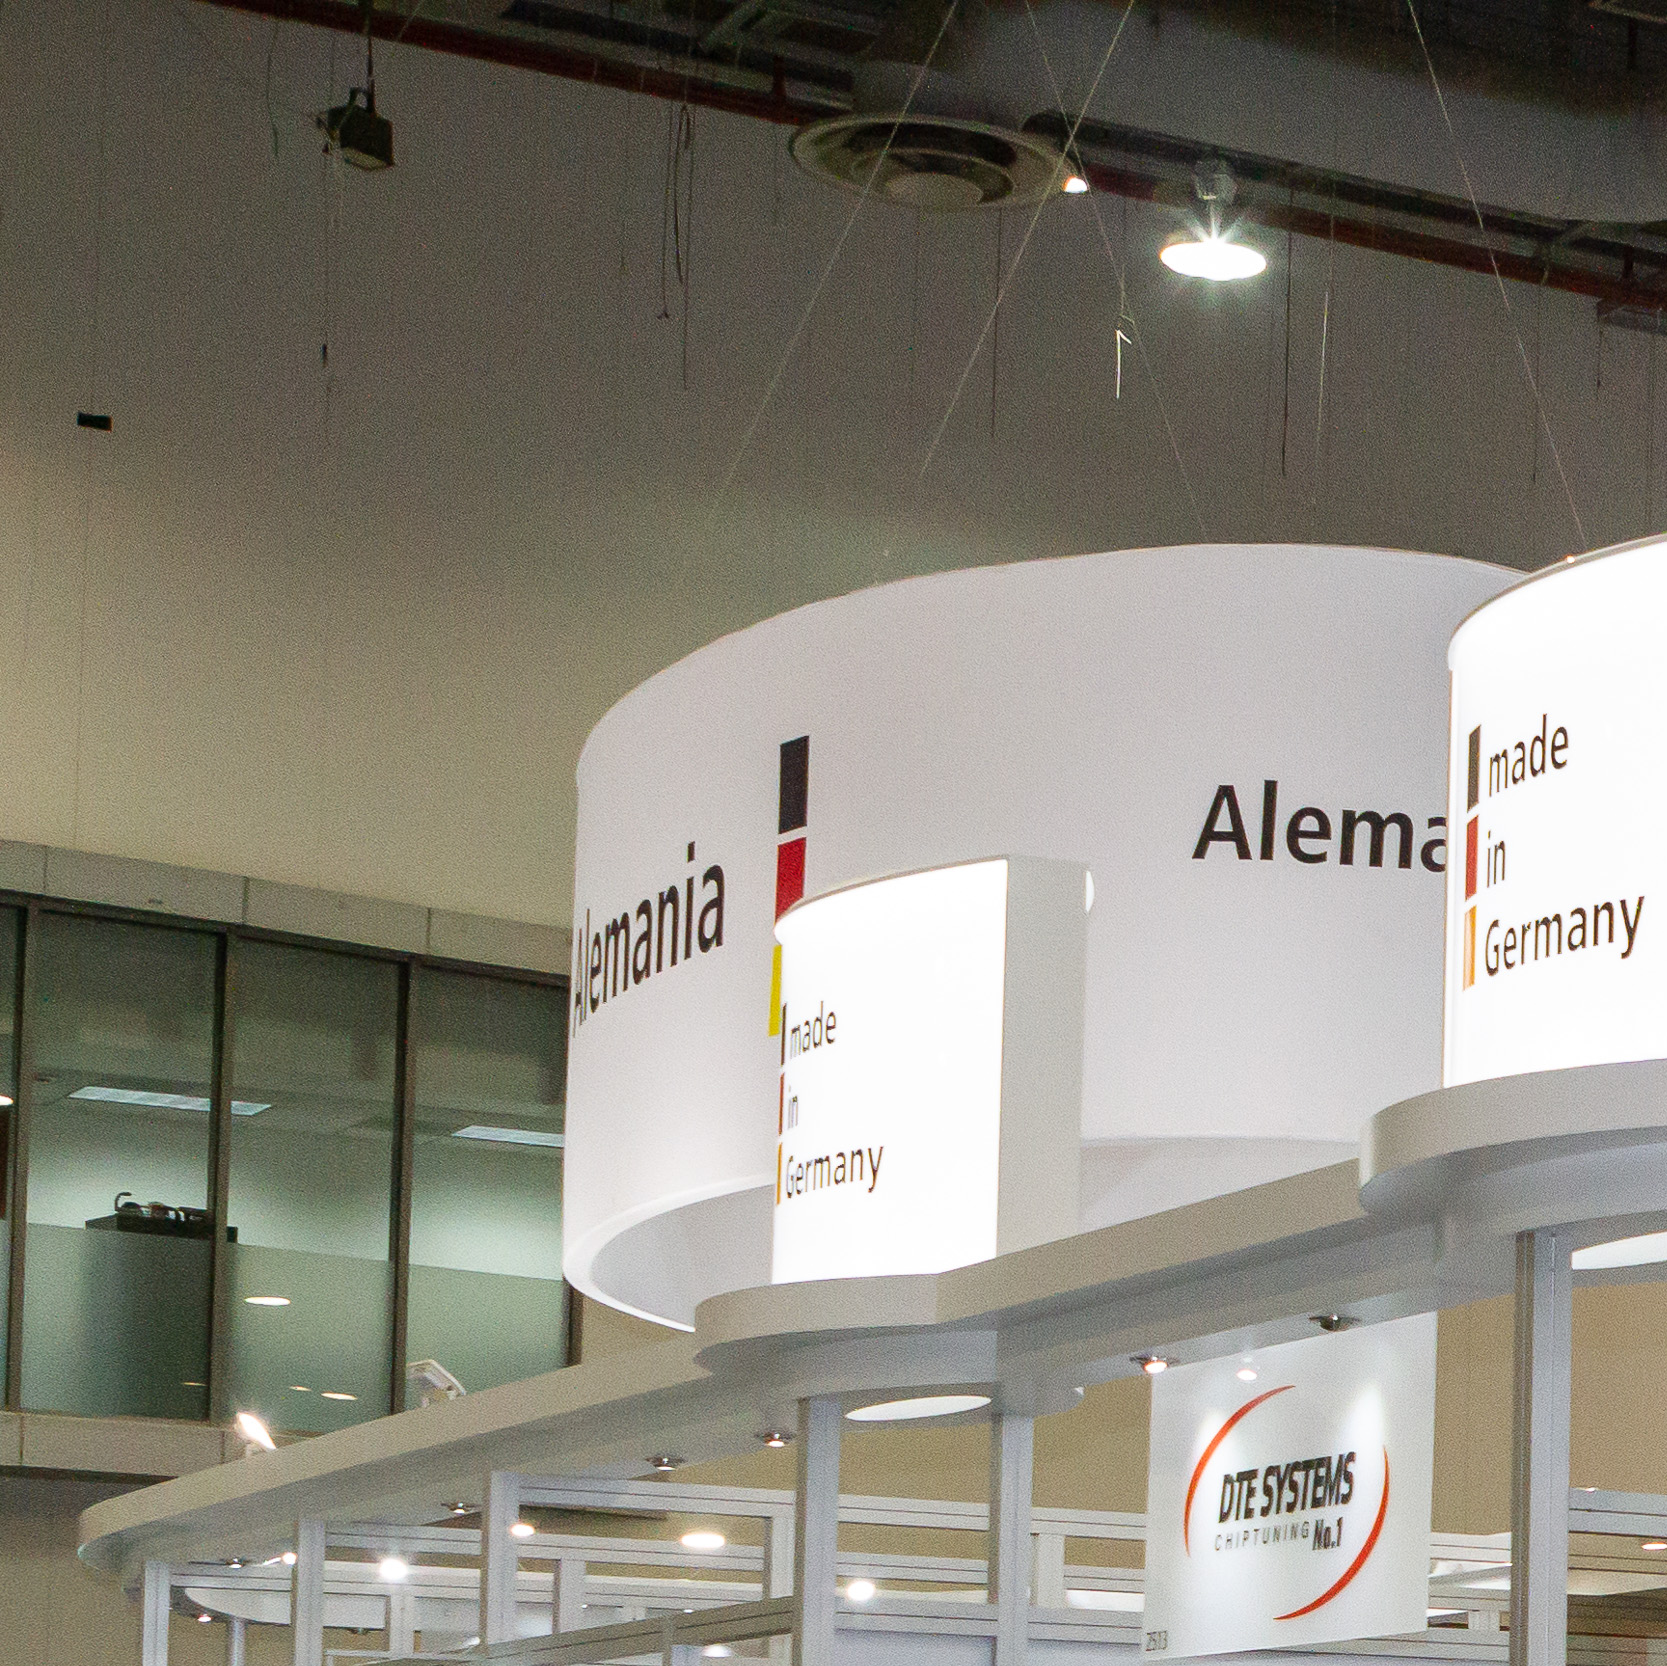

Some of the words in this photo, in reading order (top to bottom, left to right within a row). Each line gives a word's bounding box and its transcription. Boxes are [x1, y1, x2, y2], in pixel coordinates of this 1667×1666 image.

[1488, 713, 1569, 797] made
[1486, 830, 1507, 889] in
[572, 840, 725, 1039] Alemania
[1484, 895, 1646, 978] Germany
[789, 1000, 838, 1060] made
[787, 1084, 800, 1132] in
[785, 1145, 884, 1199] Germany
[1218, 1468, 1259, 1524] DTE
[1259, 1451, 1357, 1518] SYSTEMS
[1213, 1520, 1310, 1552] CHIPTUNING
